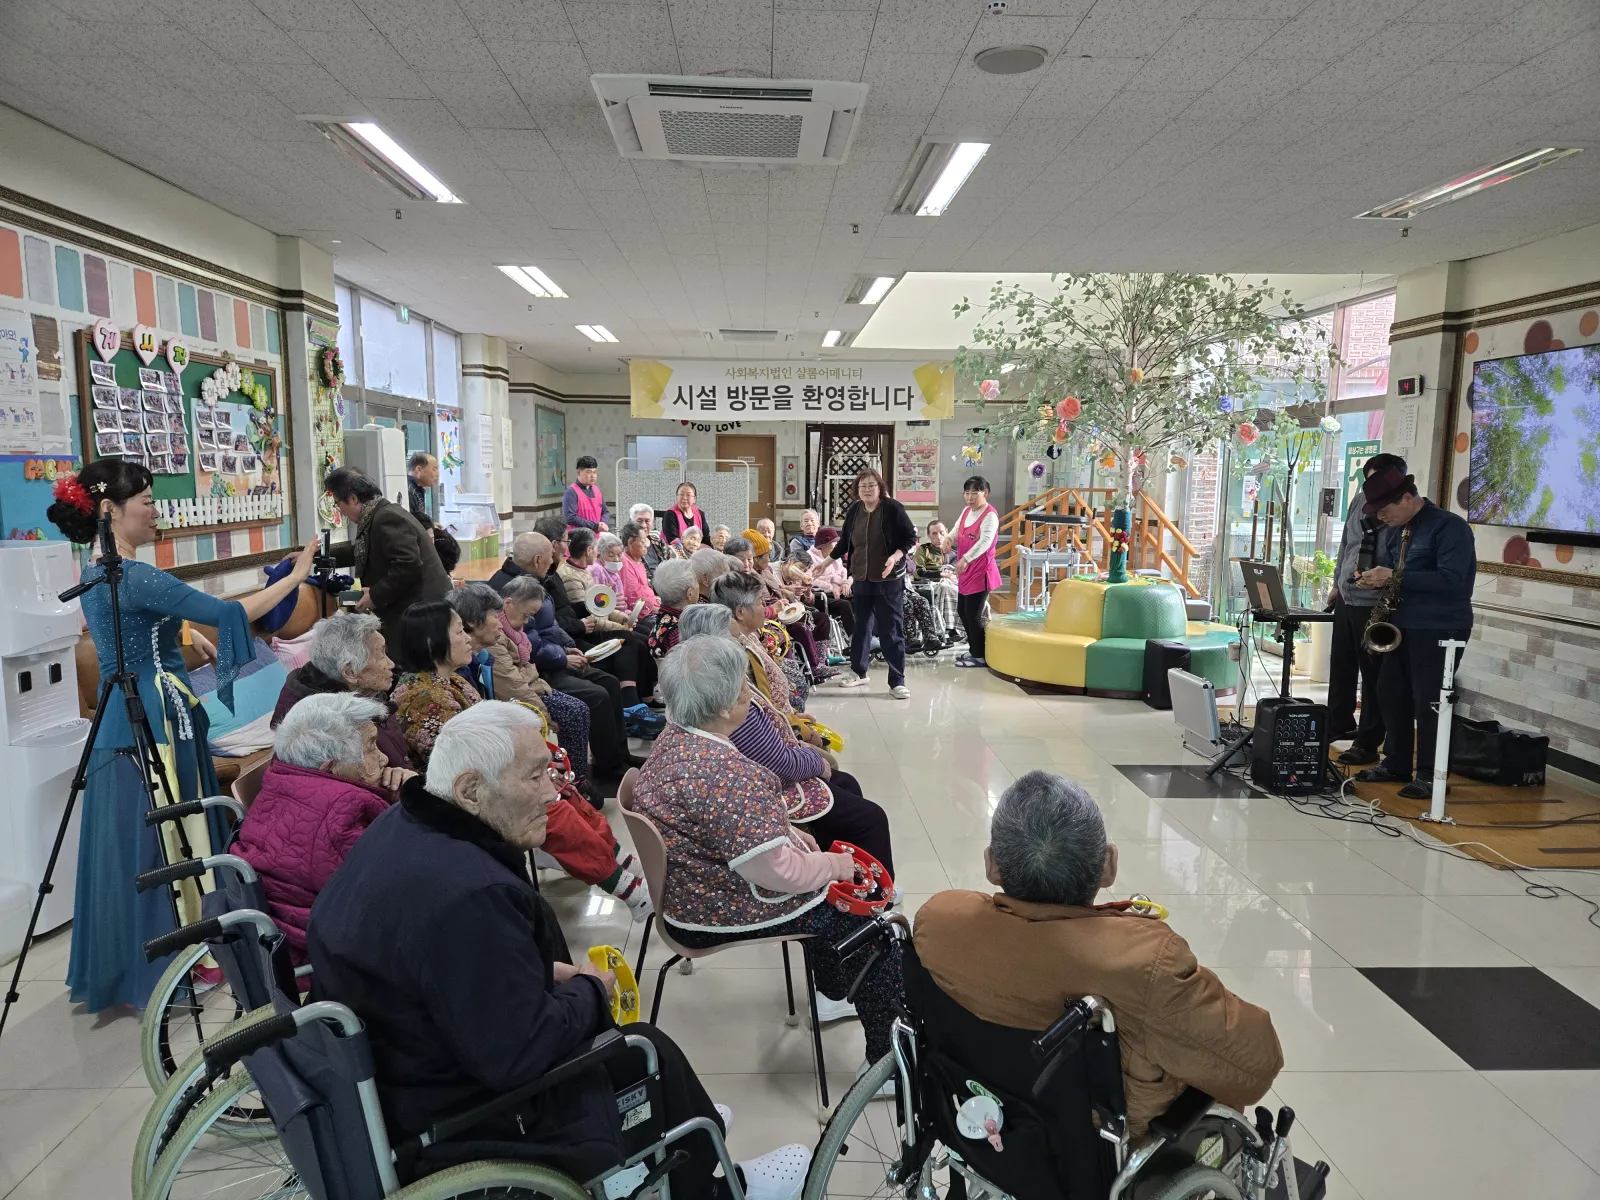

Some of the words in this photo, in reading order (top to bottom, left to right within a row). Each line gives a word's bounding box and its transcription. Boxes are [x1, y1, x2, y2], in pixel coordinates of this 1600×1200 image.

[724, 367, 793, 380] 사회복지법인
[795, 367, 863, 380] 샬롬어메니티
[672, 384, 718, 411] 시설
[726, 384, 795, 412] 방문을
[801, 384, 915, 412] 환영합니다
[690, 421, 711, 432] YOU
[716, 420, 742, 432] LOVE
